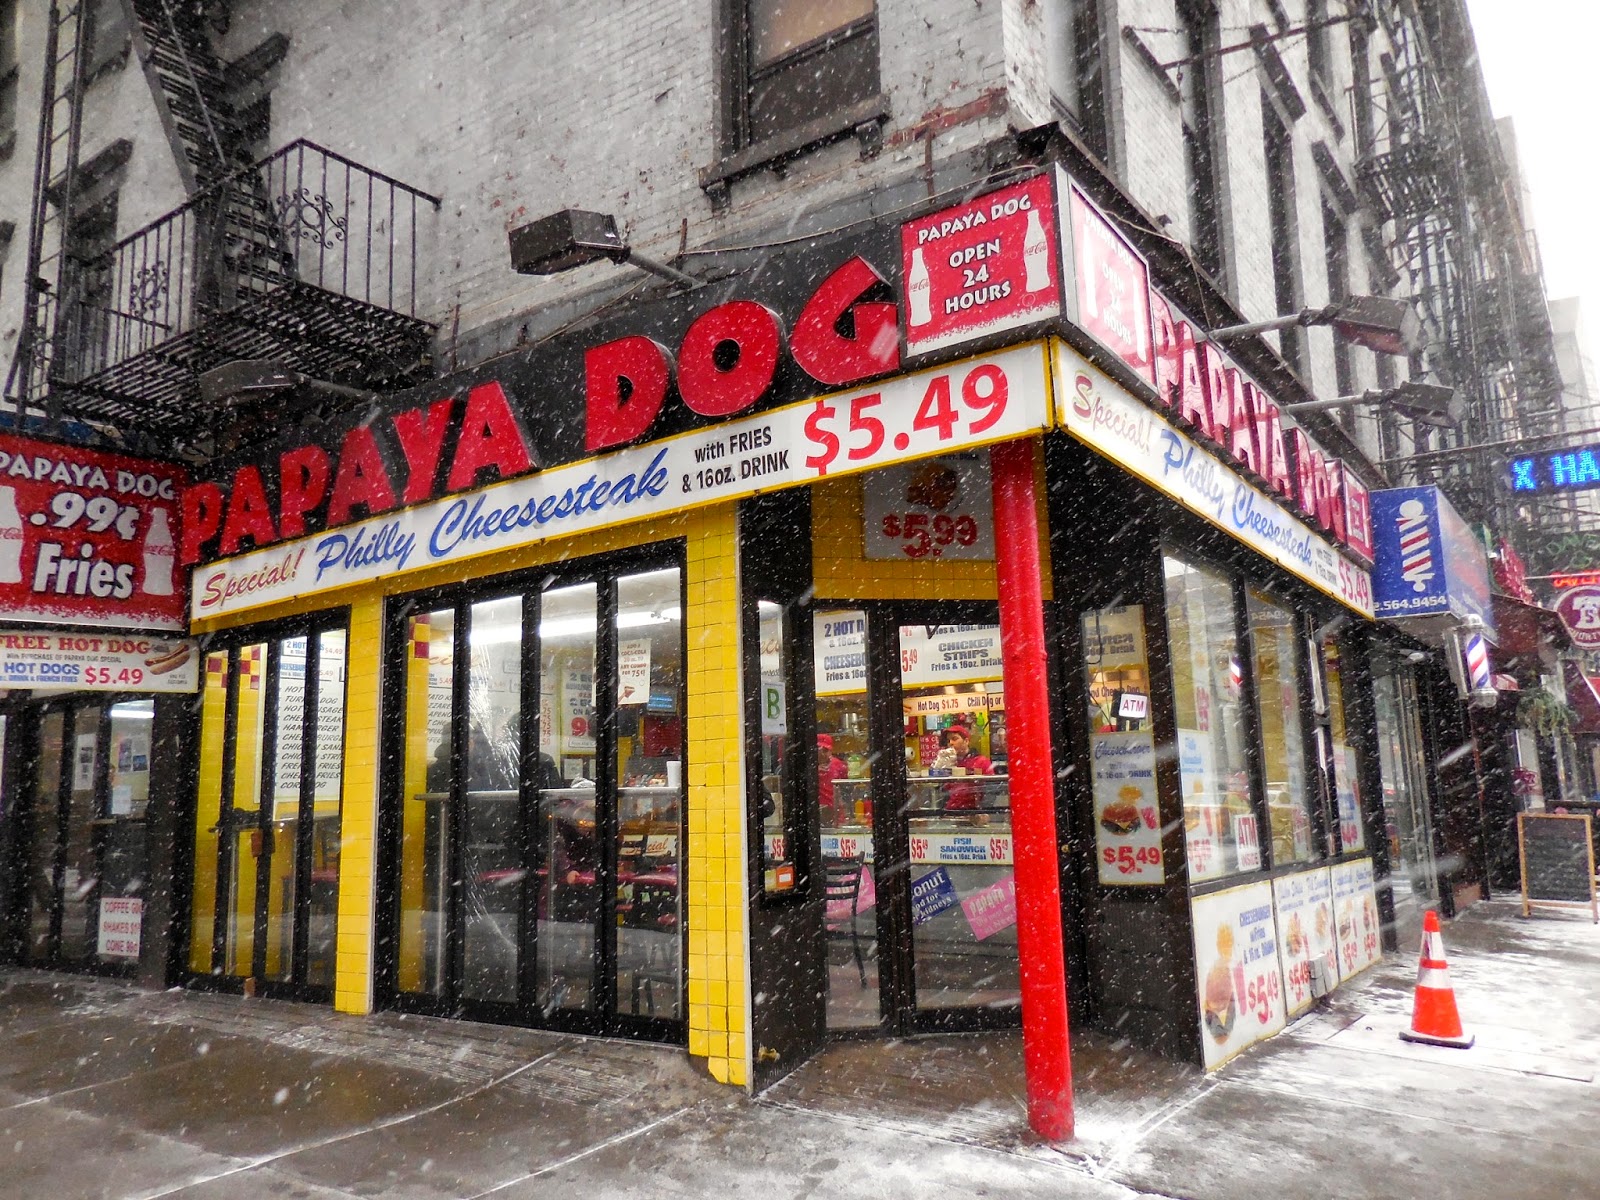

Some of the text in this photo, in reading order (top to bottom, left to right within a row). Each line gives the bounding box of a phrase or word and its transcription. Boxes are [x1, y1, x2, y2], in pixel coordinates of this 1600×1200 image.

[918, 194, 1031, 245] PAPAYA DOG
[949, 238, 1001, 268] OPEN
[963, 264, 989, 288] 24
[945, 281, 1012, 315] HOURS
[1150, 288, 1293, 500] PAPAYA
[181, 255, 899, 567] PAPAYA DOG
[804, 364, 1009, 477] $5.49
[694, 426, 772, 463] with FRIES
[0, 452, 175, 500] PAPAYA DOG
[682, 449, 789, 493] & 16oz. DRINK
[1073, 375, 1152, 453] Special!
[1160, 429, 1224, 519] Philly
[1232, 484, 1312, 566] Cheesesteak
[200, 447, 669, 608] Special! Philly Cheesesteak
[882, 512, 977, 558] $5.99
[33, 543, 134, 599] Fries
[824, 620, 855, 638] 2 HOT
[59, 637, 102, 652] HOT
[107, 639, 150, 654] DOG
[938, 638, 993, 652] CHICKEN
[943, 649, 989, 661] STRIPS
[4, 662, 143, 685] HOT DOGS $5.49
[826, 670, 844, 682] Fries
[845, 671, 850, 680] &
[931, 663, 951, 671] Fries
[952, 662, 958, 670] &
[960, 660, 979, 669] 16oz.
[767, 688, 781, 720] B
[918, 702, 928, 711] Hot
[929, 700, 940, 711] Dog
[942, 698, 959, 710] $1.75
[967, 696, 981, 708] Chili
[995, 697, 1002, 705] or
[1122, 700, 1145, 713] ATM
[1238, 816, 1258, 848] ATM
[1104, 846, 1160, 874] $5.49
[911, 871, 945, 899] onut
[926, 892, 939, 906] for
[104, 902, 130, 914] COFFEE
[920, 895, 952, 921] kidneys
[1248, 970, 1278, 1025] $5.49
